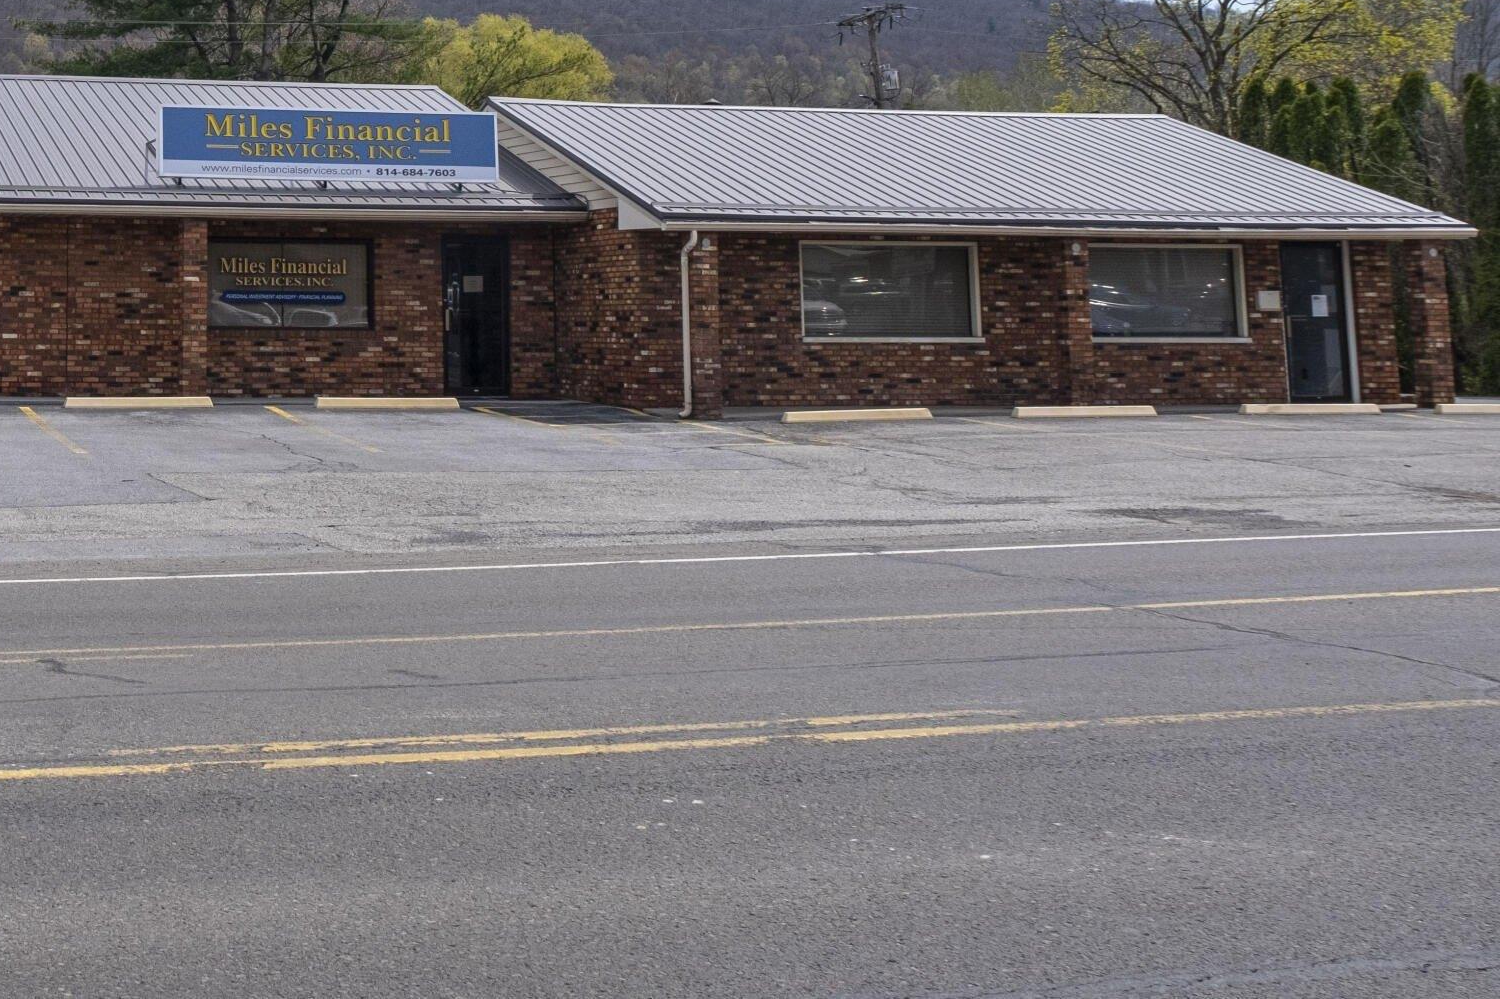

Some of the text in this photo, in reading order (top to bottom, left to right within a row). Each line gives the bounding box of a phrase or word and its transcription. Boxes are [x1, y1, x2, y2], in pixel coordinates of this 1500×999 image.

[204, 113, 452, 142] Miles Financial
[240, 141, 418, 161] SERVICES, INC.
[201, 164, 457, 178] www.milesfinancialservices.com 814-684-7603
[220, 257, 348, 275] Miles Financial
[307, 277, 334, 287] INC.
